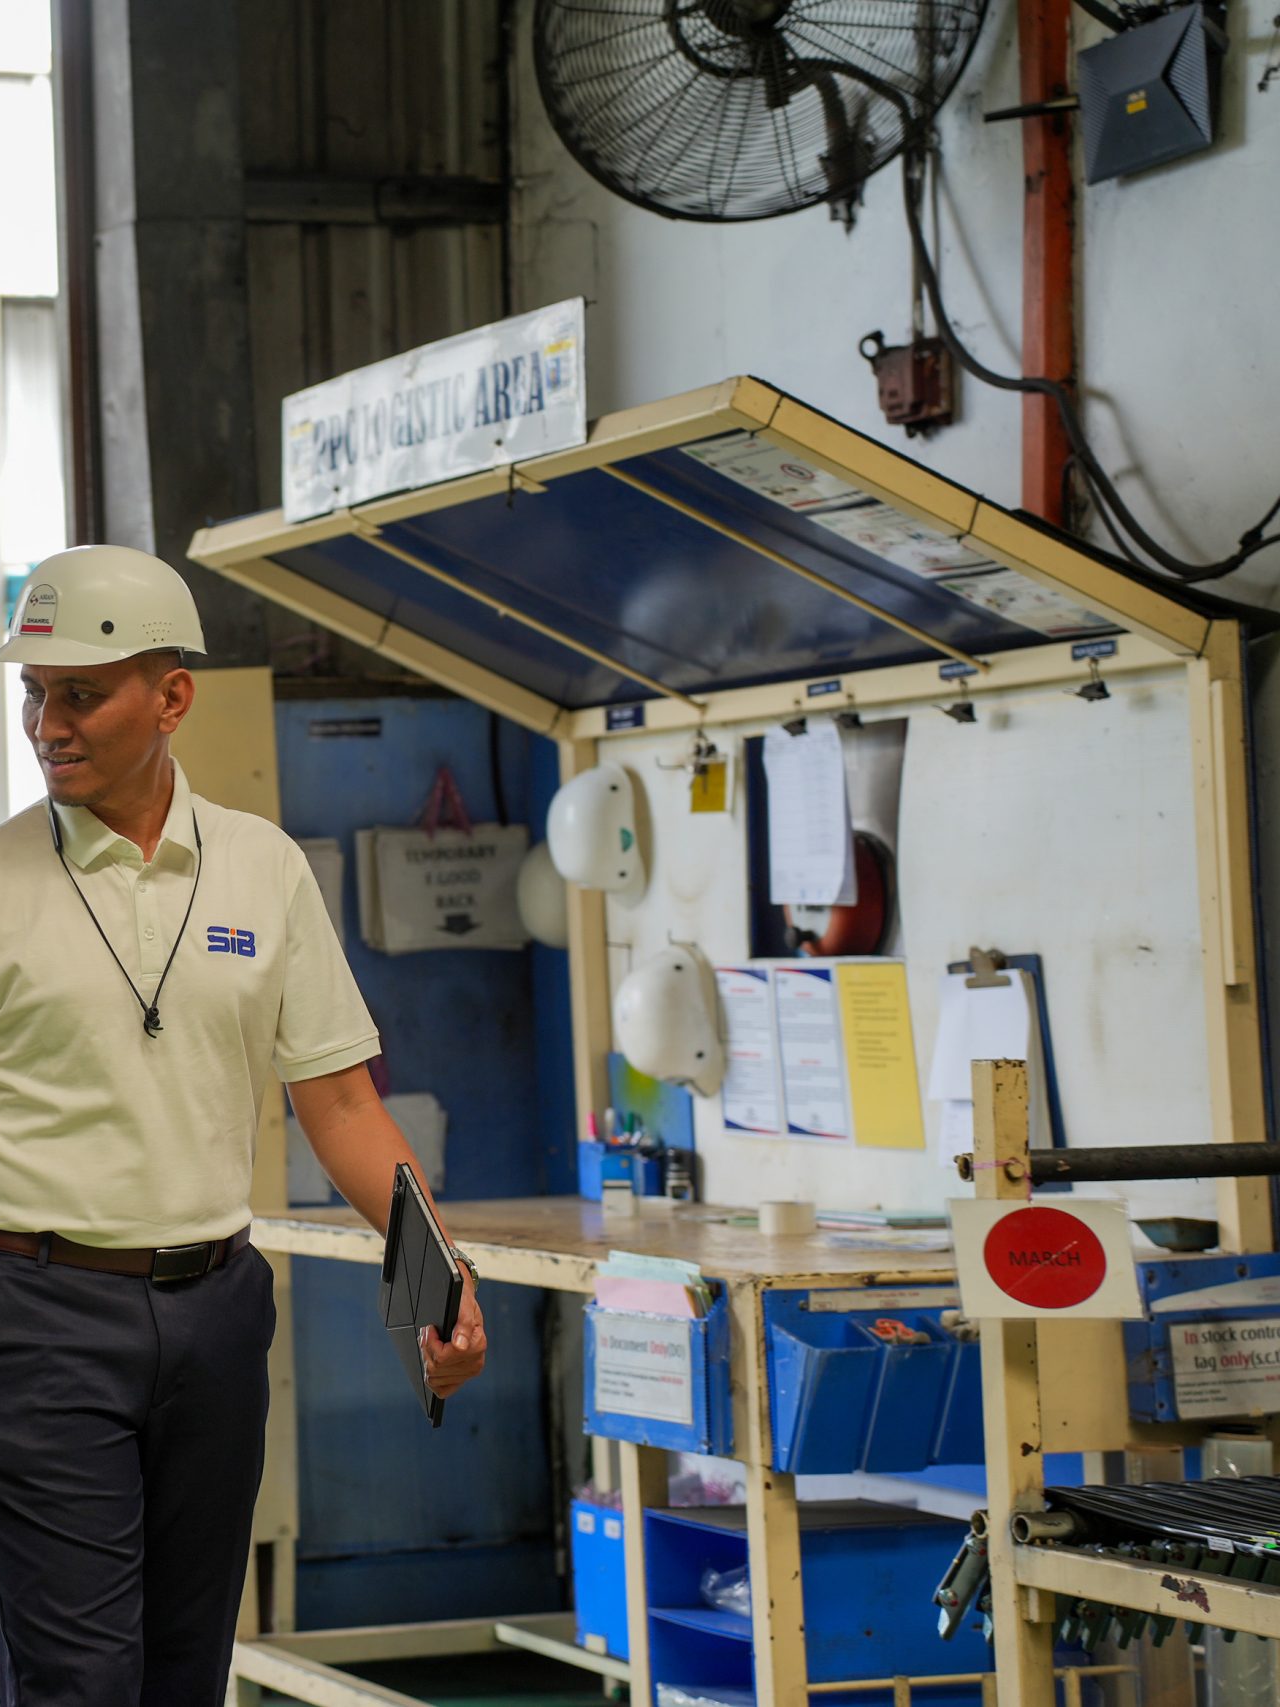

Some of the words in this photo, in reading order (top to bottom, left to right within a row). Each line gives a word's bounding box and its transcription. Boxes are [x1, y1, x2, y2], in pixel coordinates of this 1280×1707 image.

[474, 350, 545, 429] AREA
[1008, 1251, 1082, 1267] MARCH
[609, 1335, 648, 1353] Document
[1183, 1330, 1199, 1345] In
[1201, 1326, 1237, 1344] stock
[1194, 1355, 1217, 1371] tag
